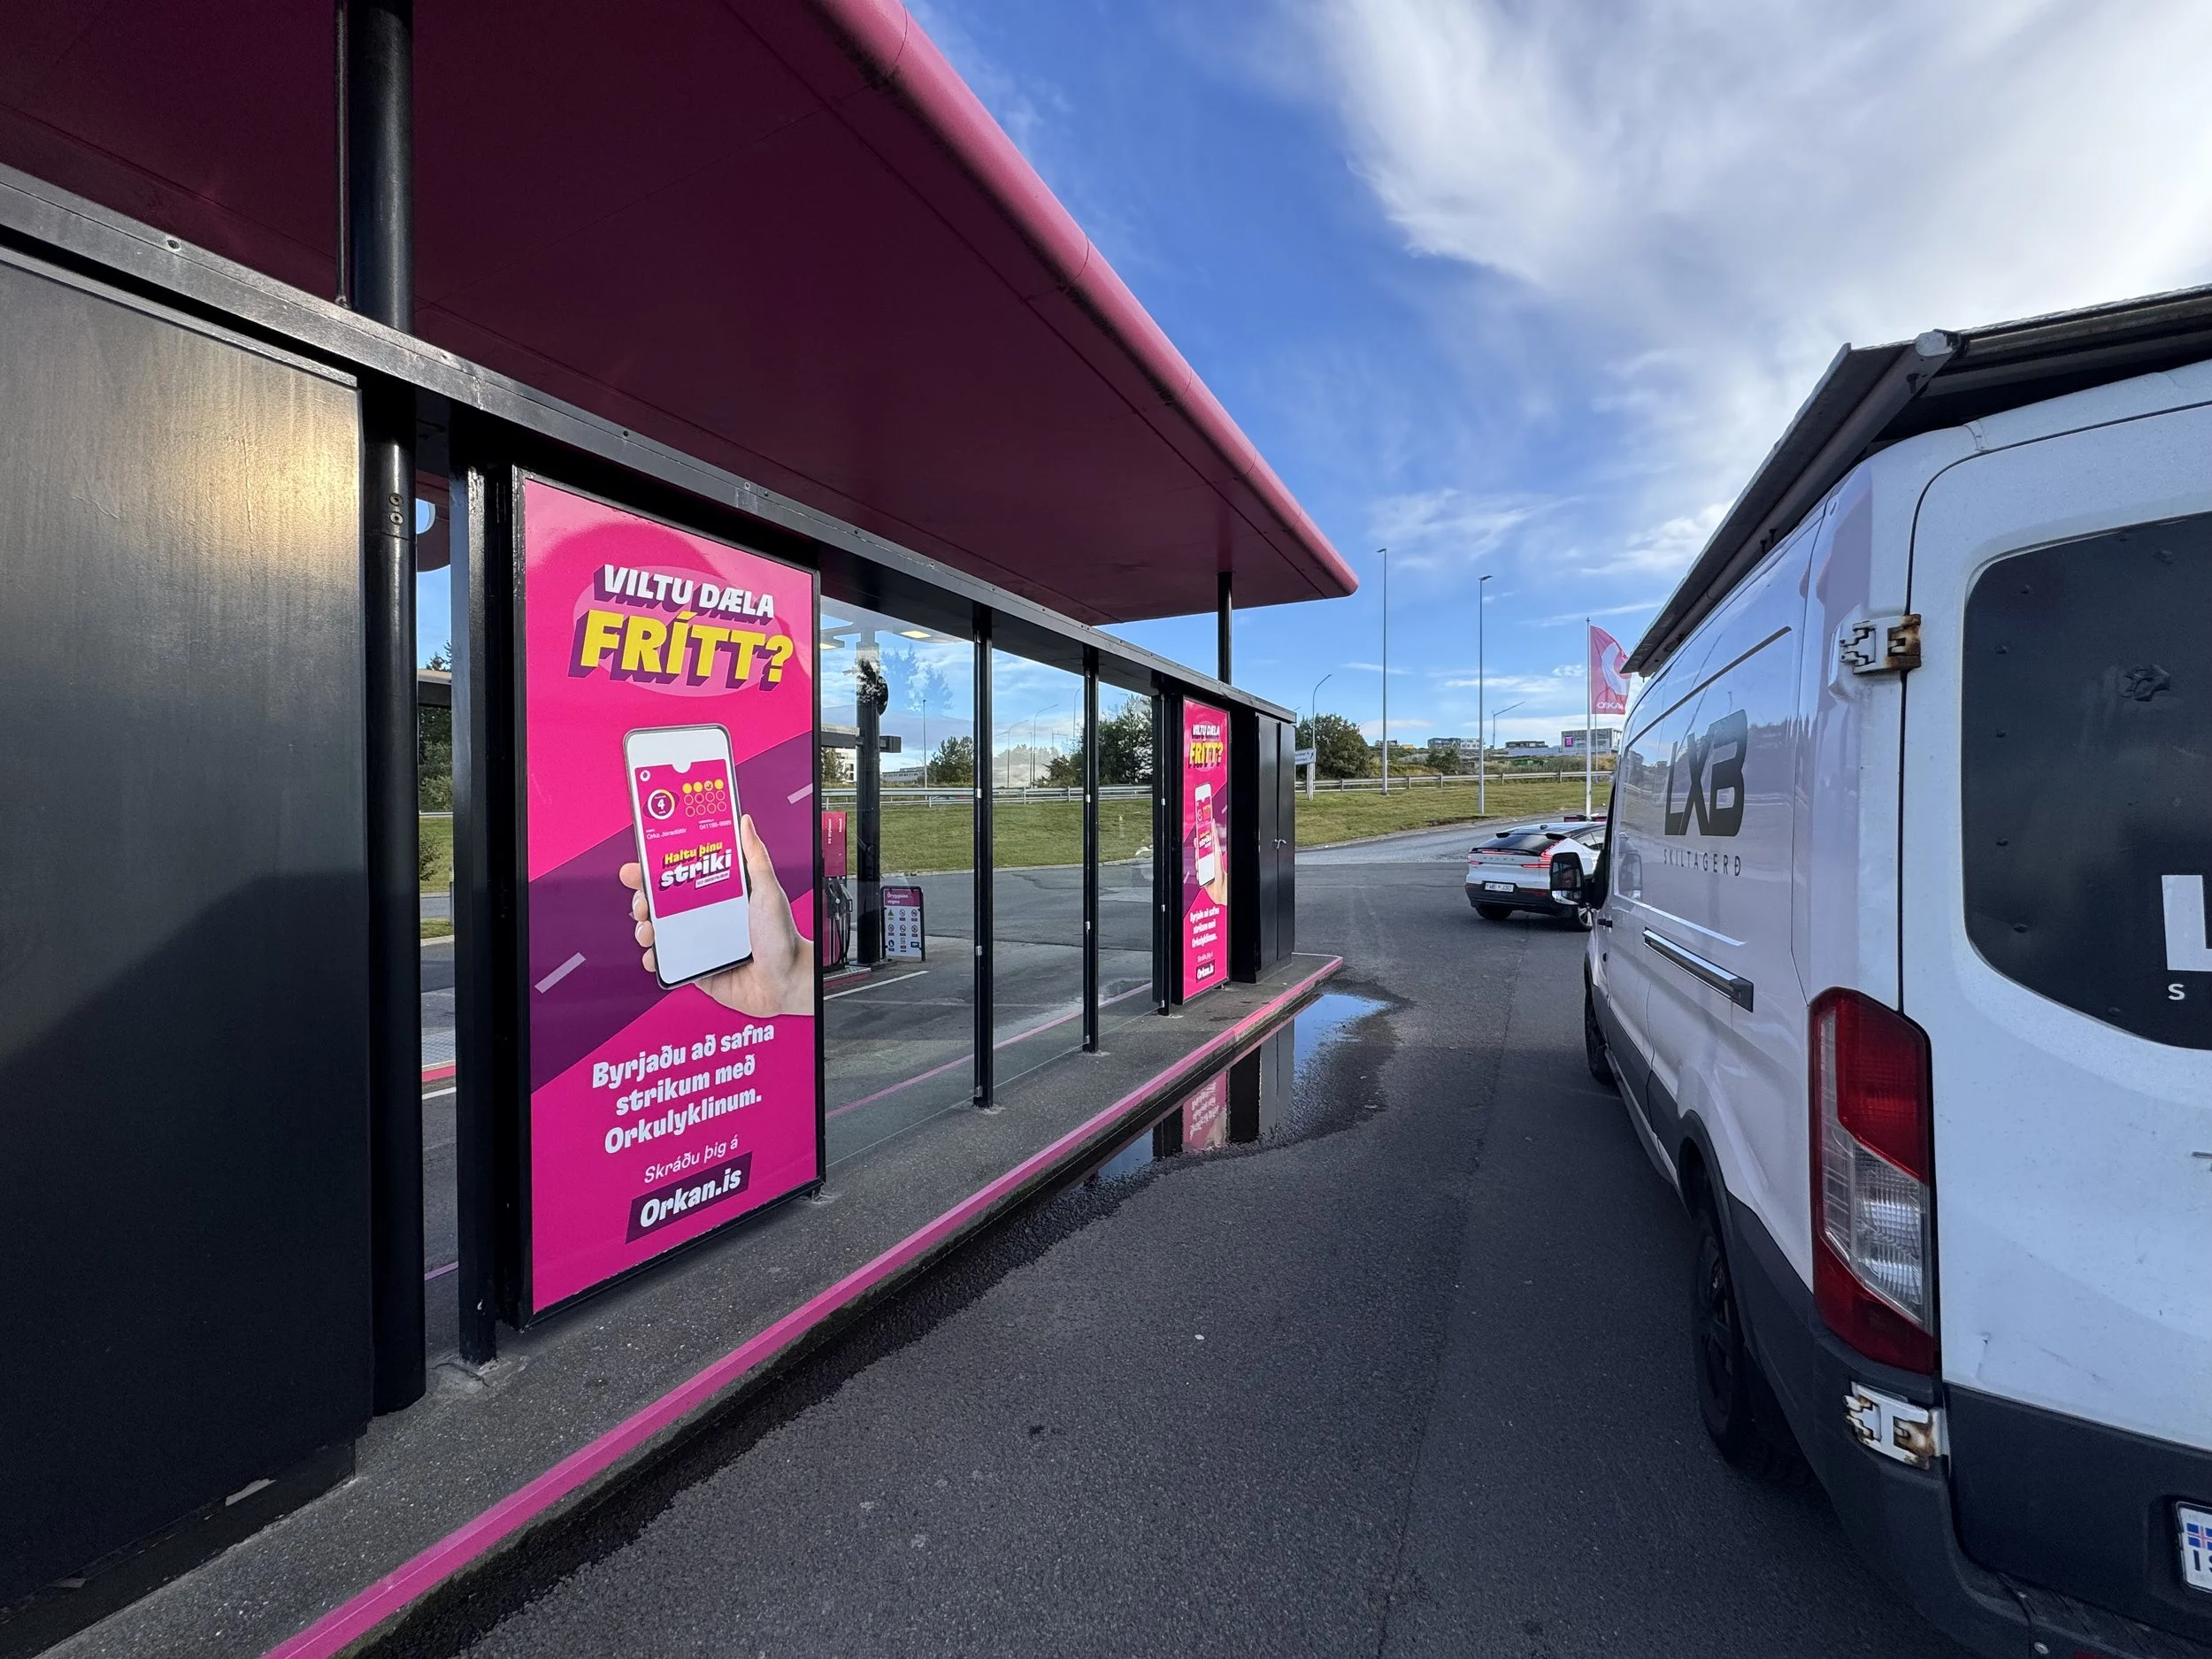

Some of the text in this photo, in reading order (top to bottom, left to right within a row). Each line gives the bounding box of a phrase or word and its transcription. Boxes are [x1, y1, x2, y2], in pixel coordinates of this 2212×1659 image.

[603, 564, 774, 618] VILTU DÆLA
[580, 609, 794, 683] FRÍTT?
[1189, 739, 1224, 764] FRÍTT?
[1664, 709, 1748, 837] LXB
[657, 798, 665, 810] 4
[660, 848, 732, 887] striki
[664, 849, 697, 865] Haltu
[1663, 849, 1741, 877] SKILTAGERÐ
[592, 1024, 775, 1089] Byrjaðu að safna
[615, 1054, 756, 1117] strikum með
[604, 1087, 763, 1155] Orkulyklinum.
[643, 1133, 740, 1184] Skráðu þig á
[639, 1167, 742, 1228] Orkan.is
[2193, 1549, 2212, 1573] I
